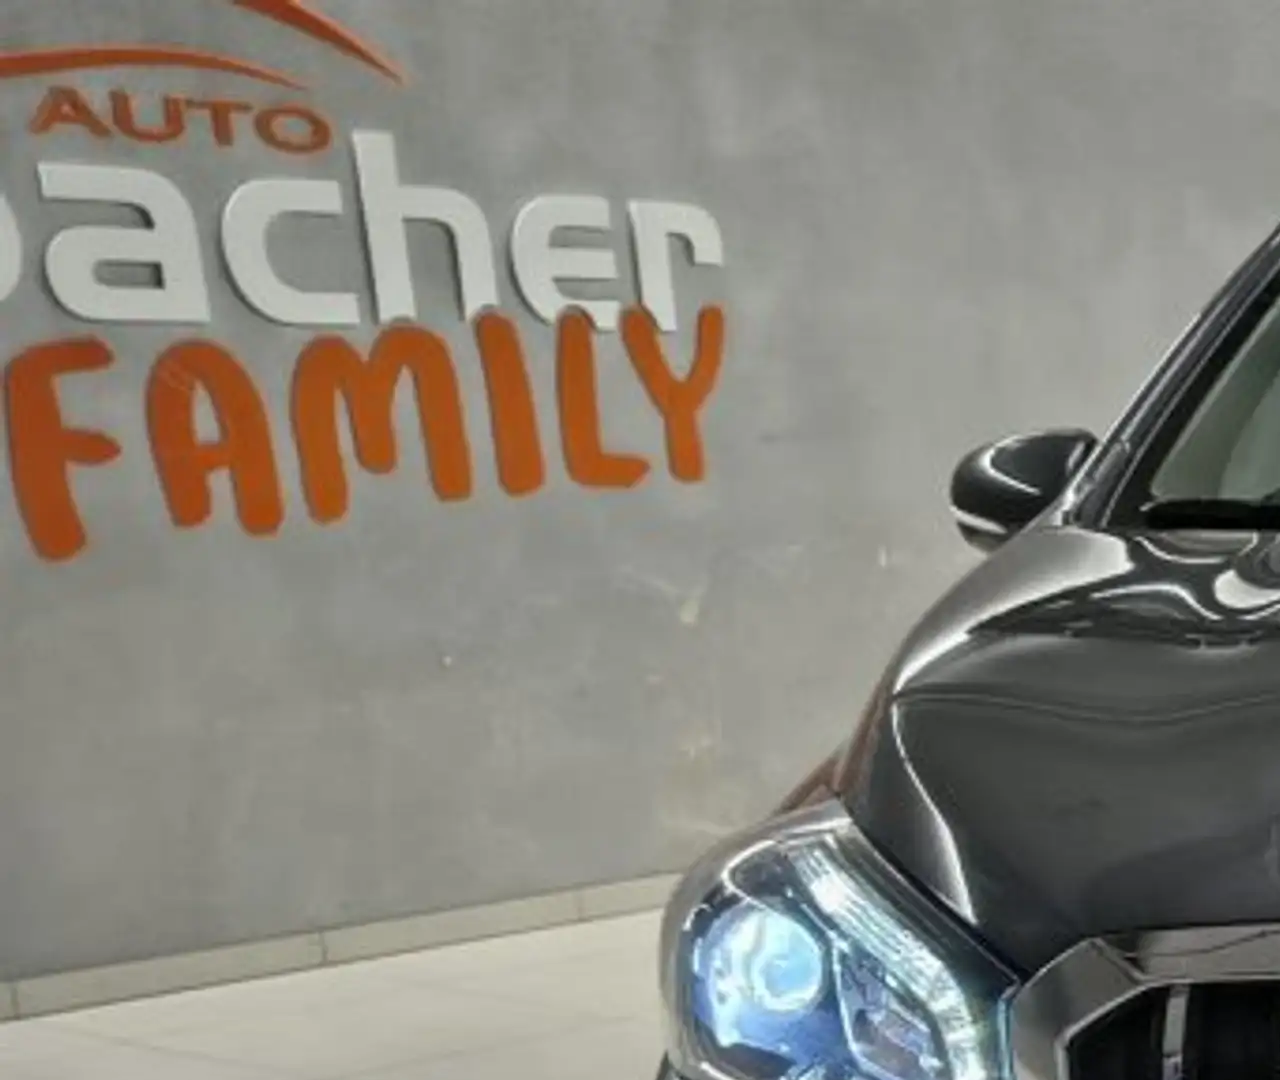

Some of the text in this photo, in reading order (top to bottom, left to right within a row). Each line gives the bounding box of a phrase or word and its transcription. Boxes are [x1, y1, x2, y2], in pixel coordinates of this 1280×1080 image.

[28, 86, 332, 154] AUTO
[0, 130, 724, 332] acher
[4, 304, 725, 562] FAMILY
